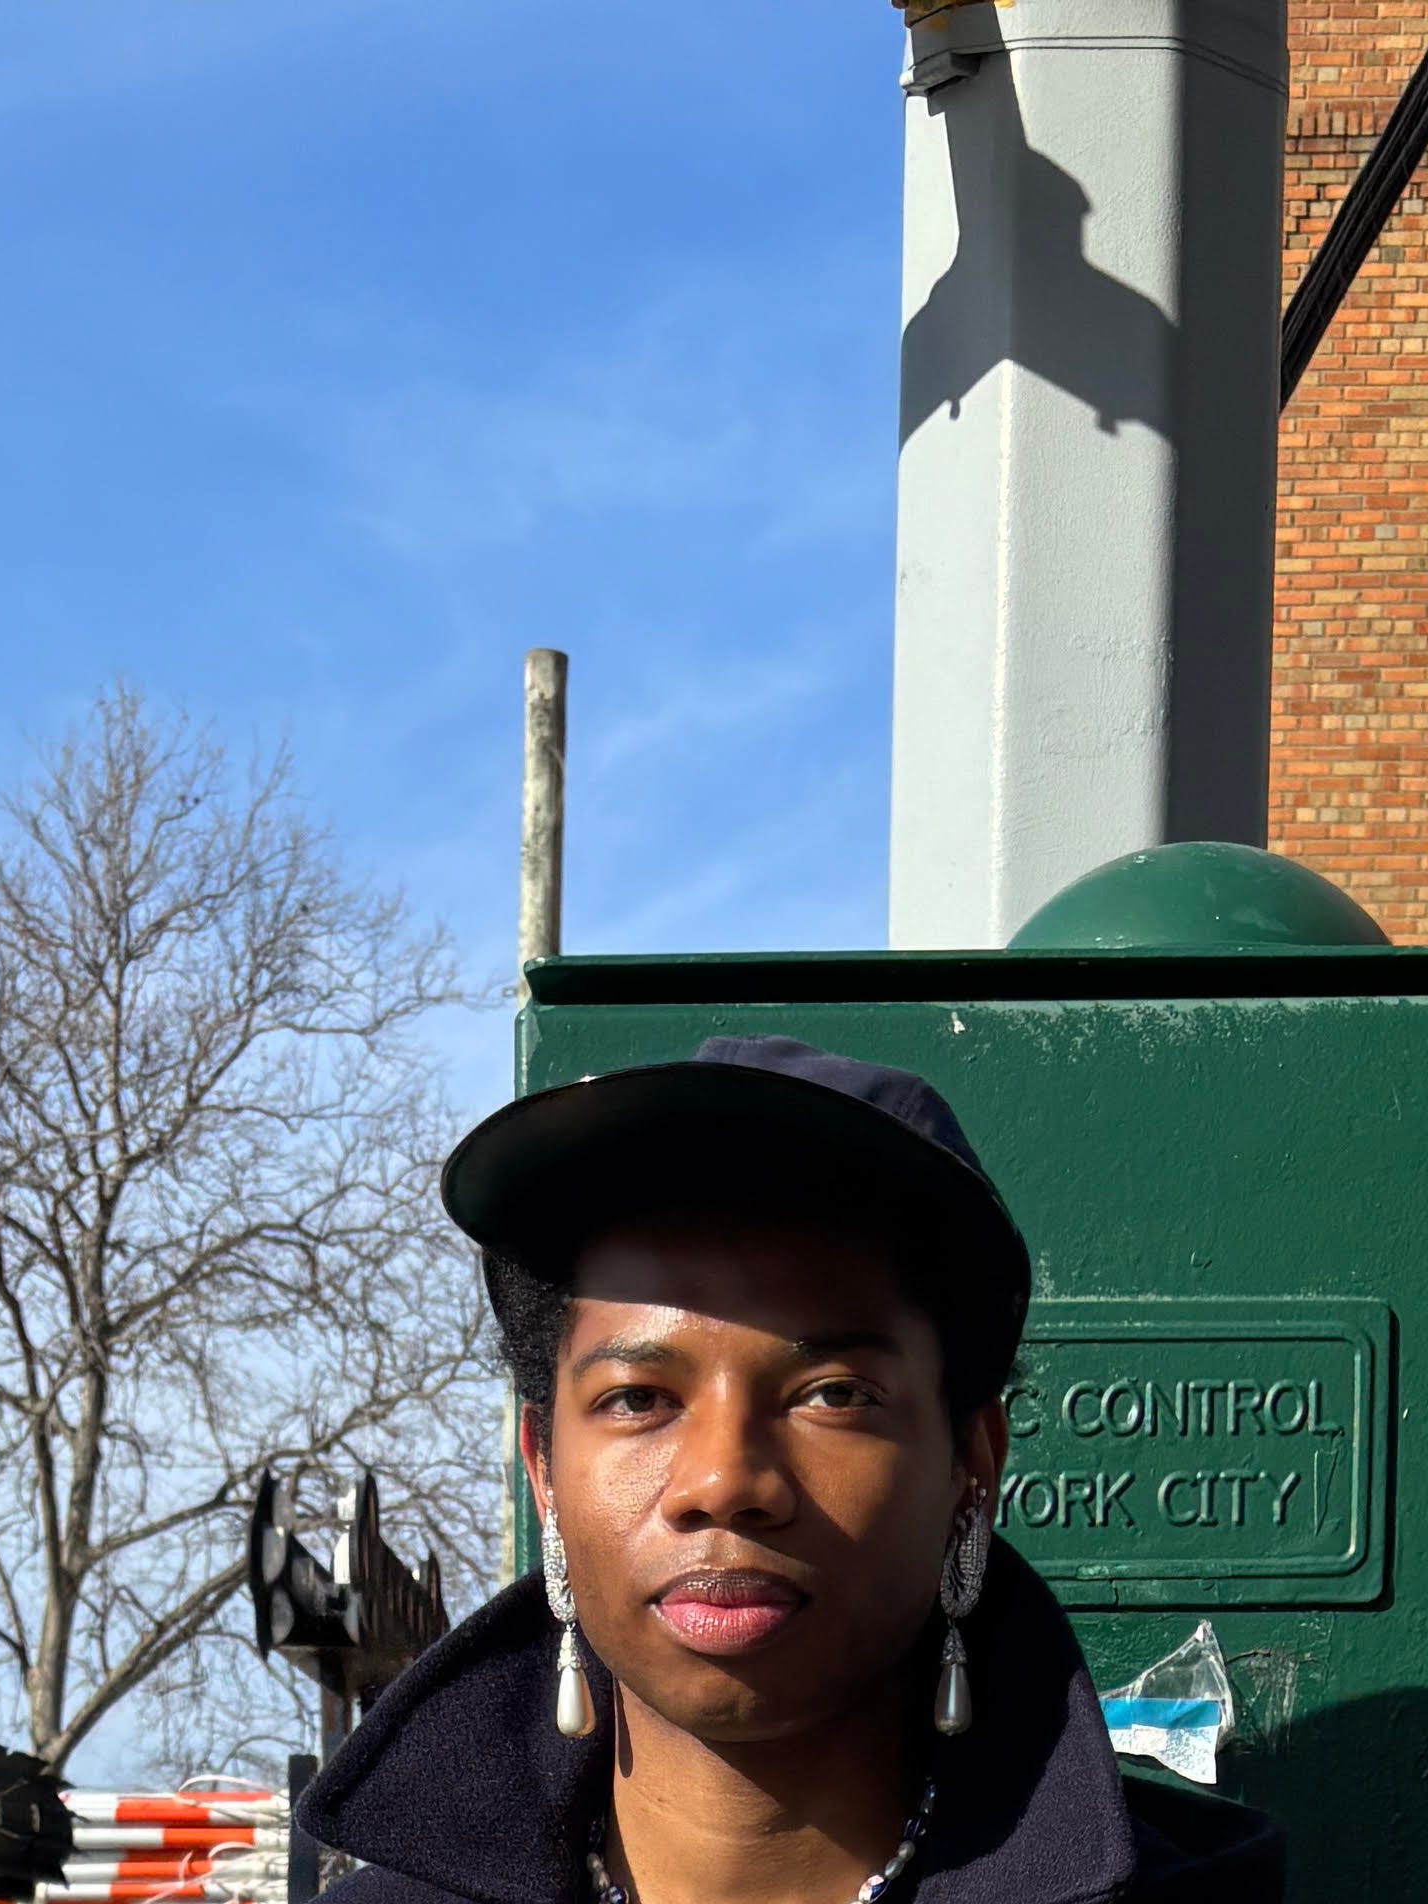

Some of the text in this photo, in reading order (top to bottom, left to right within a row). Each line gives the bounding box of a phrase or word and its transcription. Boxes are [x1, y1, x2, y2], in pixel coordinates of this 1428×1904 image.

[1062, 1378, 1344, 1438] CONTROL
[995, 1471, 1301, 1529] YORK CITY
